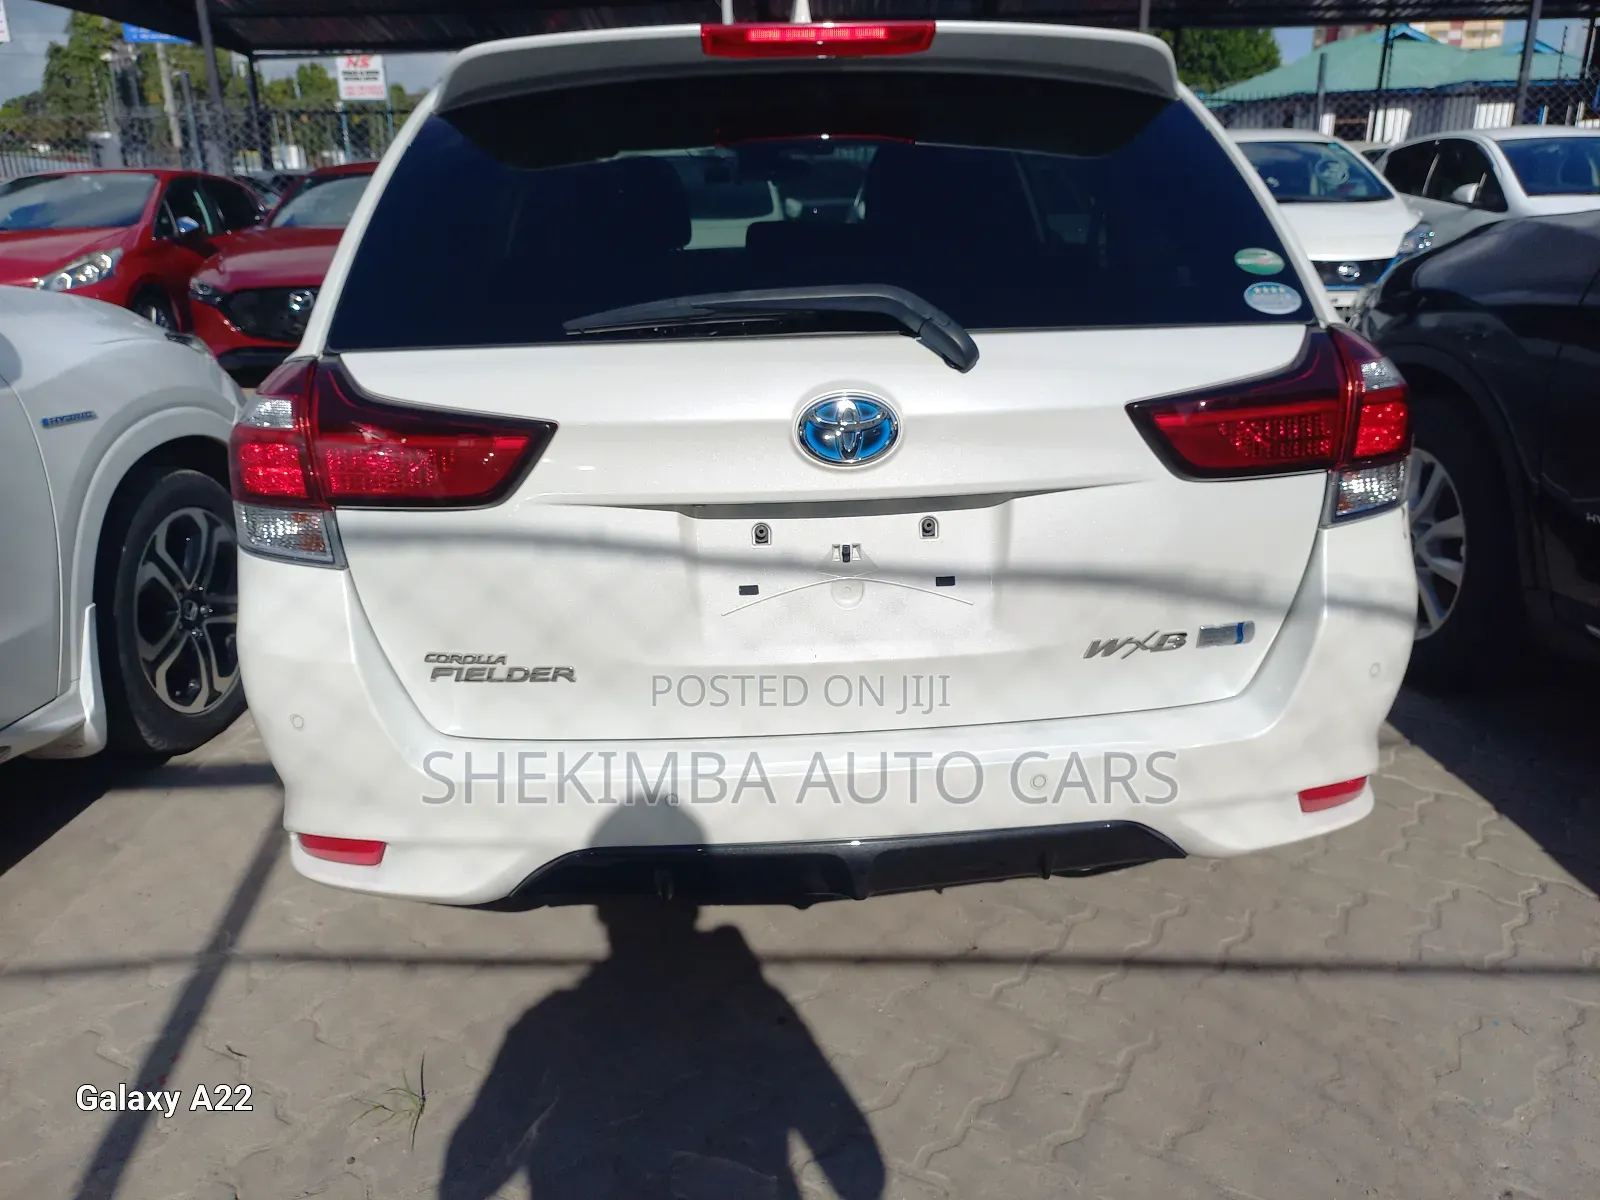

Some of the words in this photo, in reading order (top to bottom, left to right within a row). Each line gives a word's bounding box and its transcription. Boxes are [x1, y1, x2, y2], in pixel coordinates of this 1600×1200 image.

[1083, 629, 1188, 660] WXB
[424, 653, 507, 665] COROLLA
[430, 666, 577, 683] FIELDER
